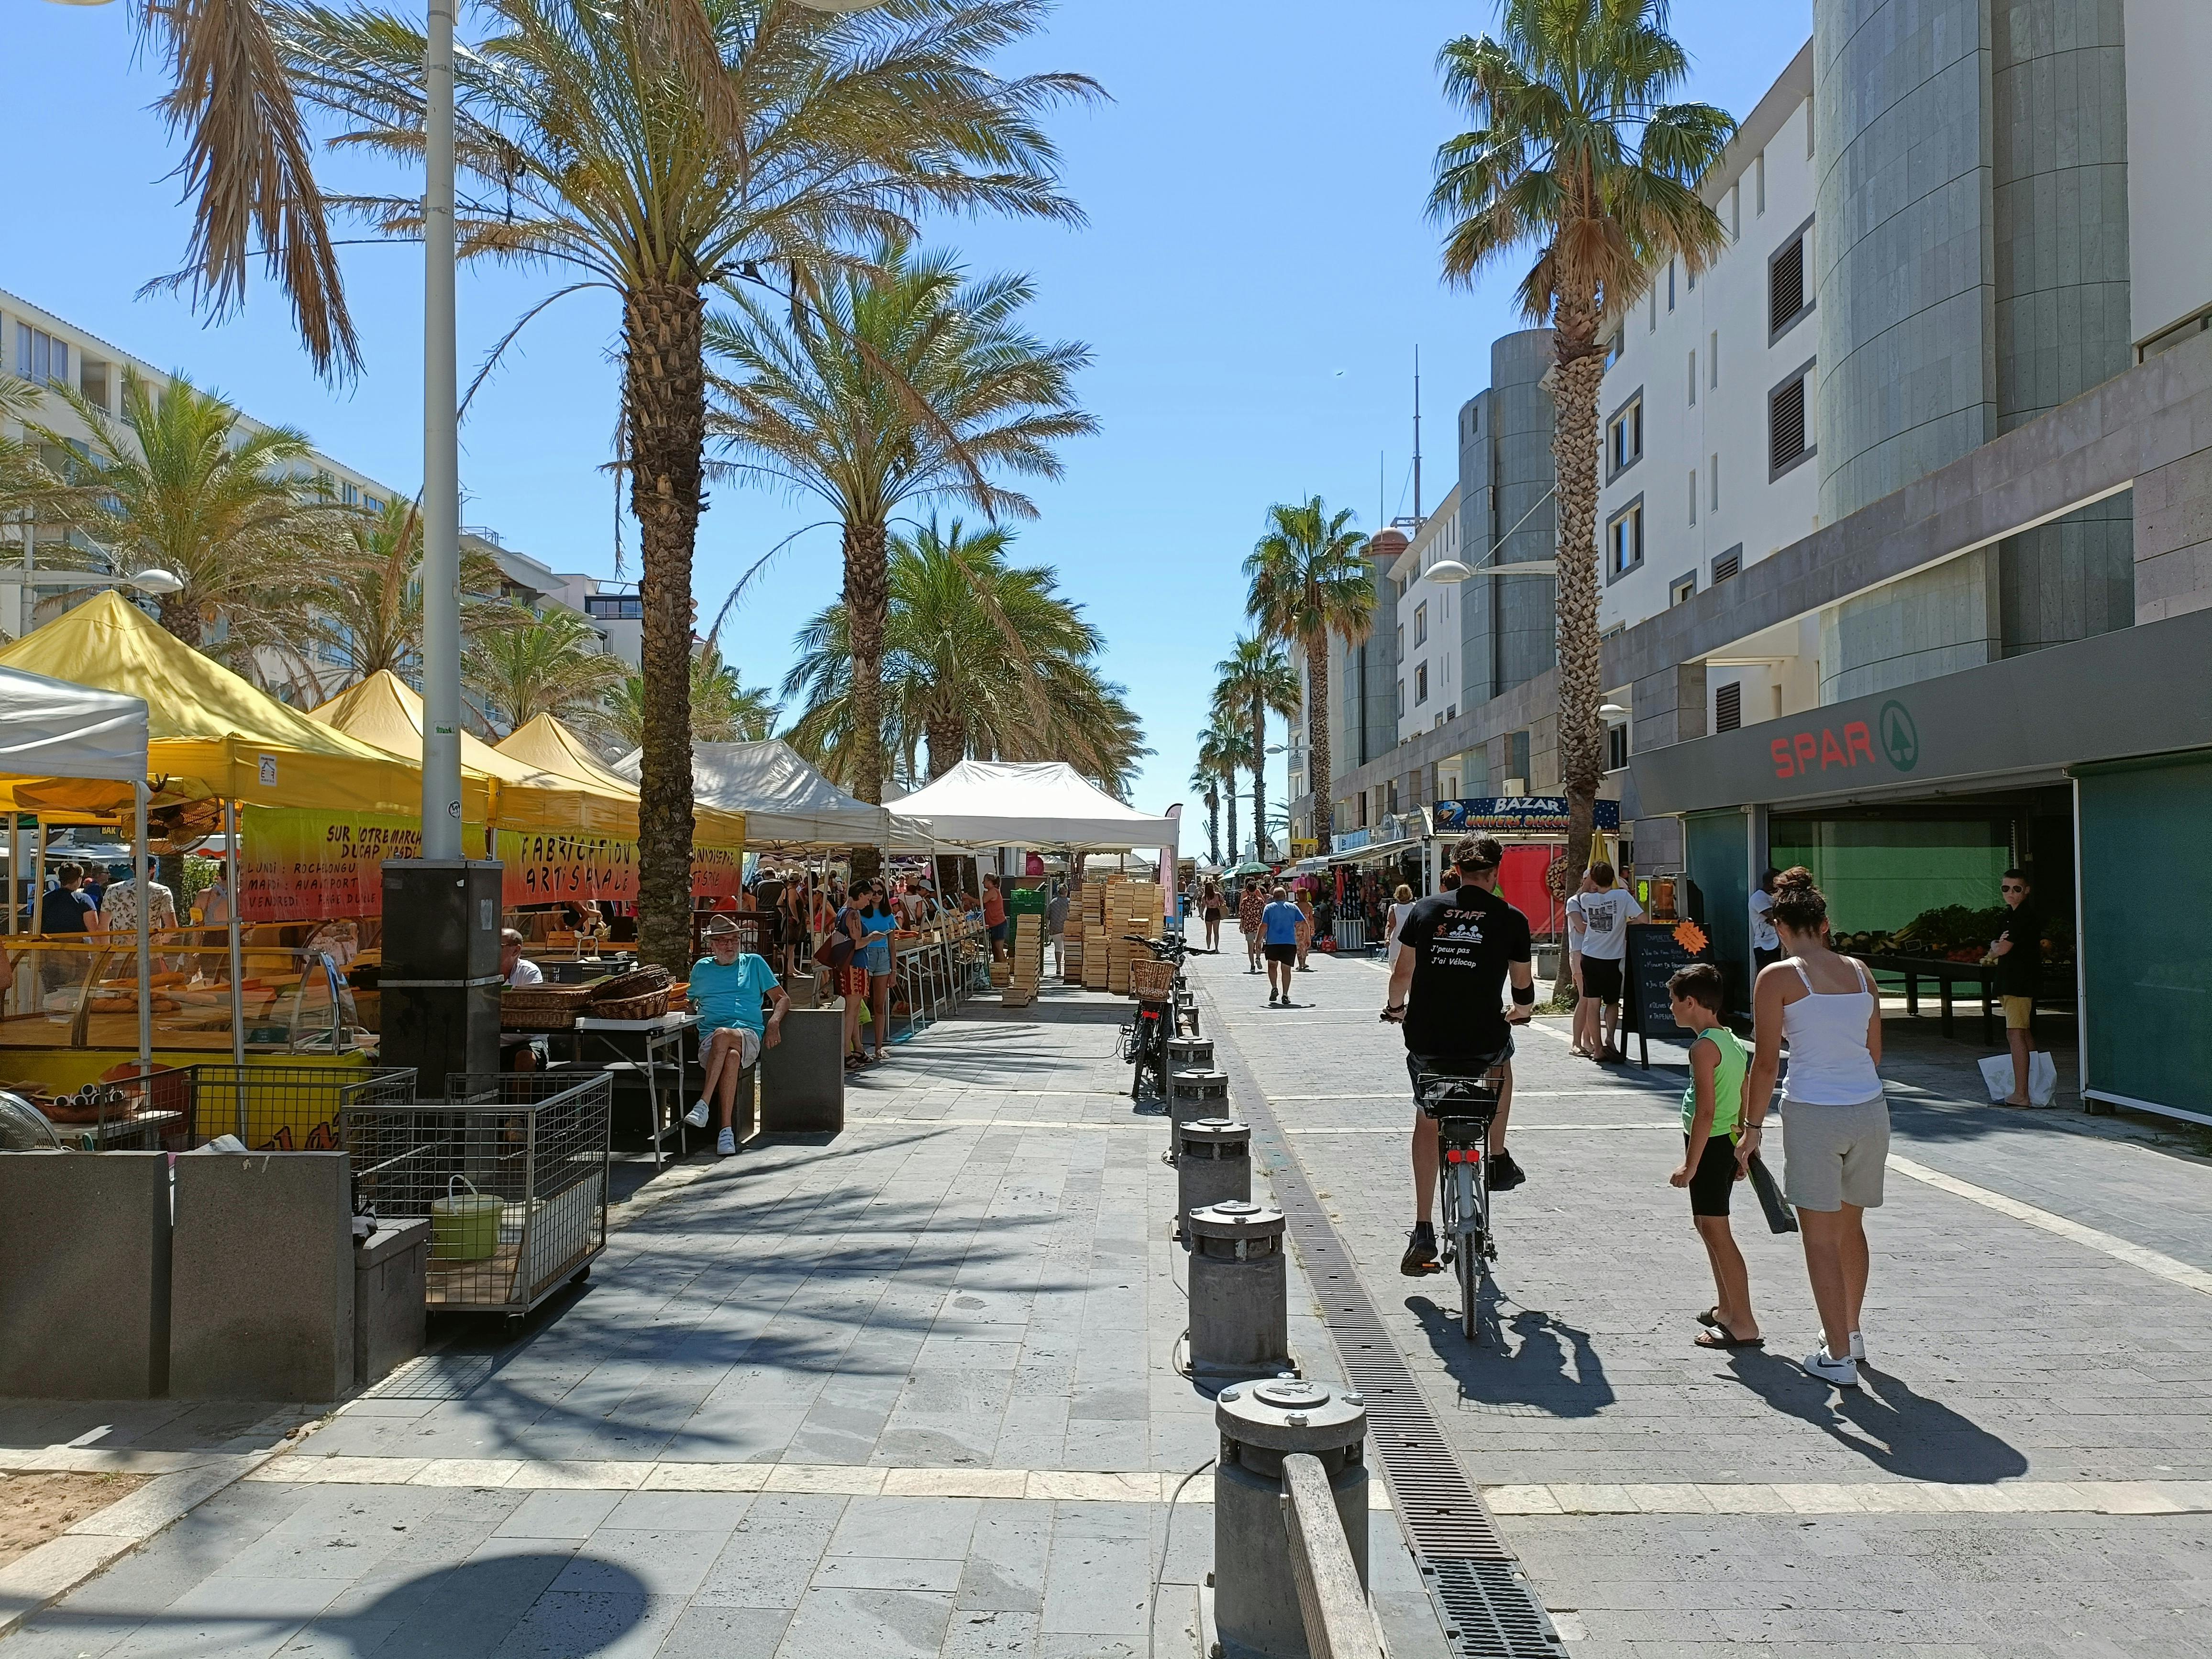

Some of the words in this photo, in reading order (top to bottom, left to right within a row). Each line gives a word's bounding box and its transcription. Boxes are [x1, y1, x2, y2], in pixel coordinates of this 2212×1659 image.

[1771, 721, 1876, 778] SPAR
[1493, 797, 1560, 814] BAZAR
[1465, 815, 1522, 828] UNIVERS
[1524, 815, 1570, 828] DISCOU
[327, 825, 350, 842] SUR
[390, 829, 422, 845] MARCH
[522, 836, 630, 864] FABRICATION
[330, 878, 359, 889] PORT
[1444, 909, 1486, 920] STAFF
[1430, 945, 1455, 954] J'peux
[1449, 958, 1476, 968] Vélocap
